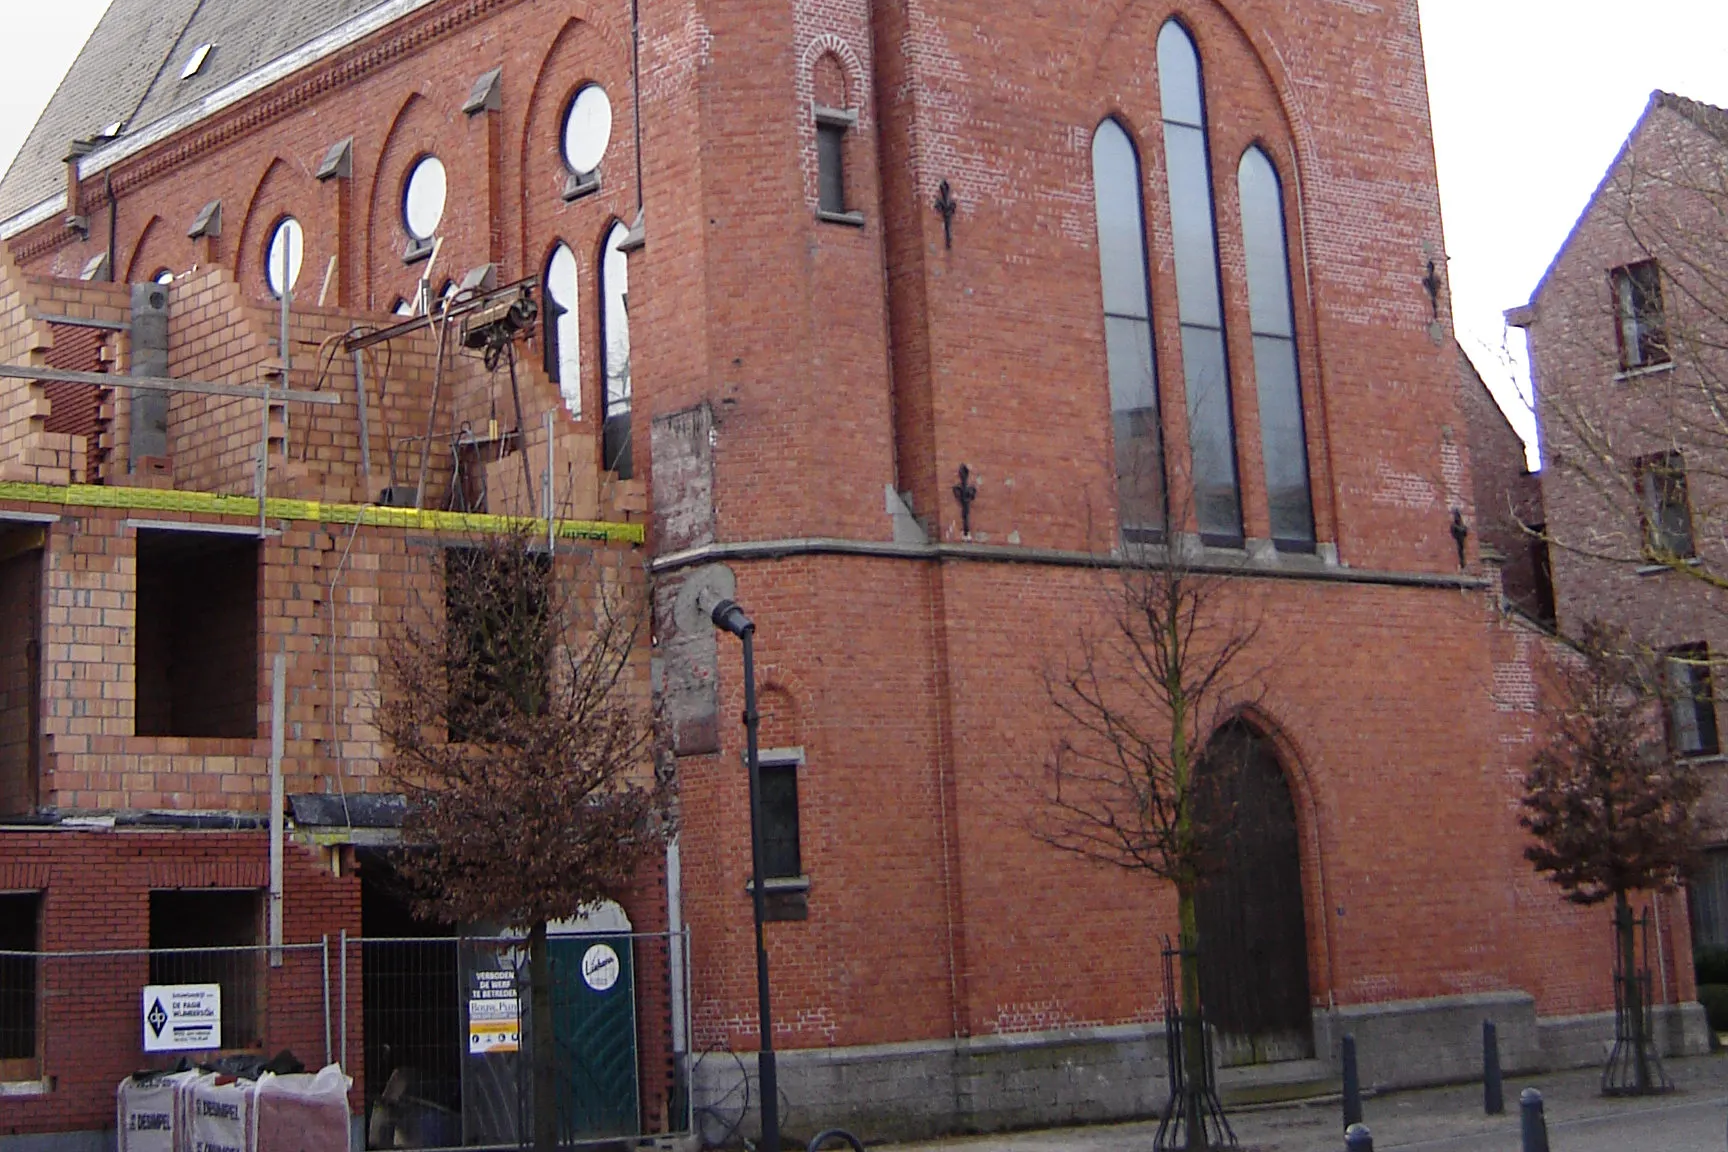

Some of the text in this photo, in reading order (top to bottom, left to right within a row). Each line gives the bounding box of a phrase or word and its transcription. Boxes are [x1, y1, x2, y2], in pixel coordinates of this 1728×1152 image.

[475, 971, 515, 980] VERBODEN
[480, 980, 511, 989] DE WERF
[472, 989, 518, 998] TE BETREDEN
[137, 1112, 171, 1130] DESIMPEL
